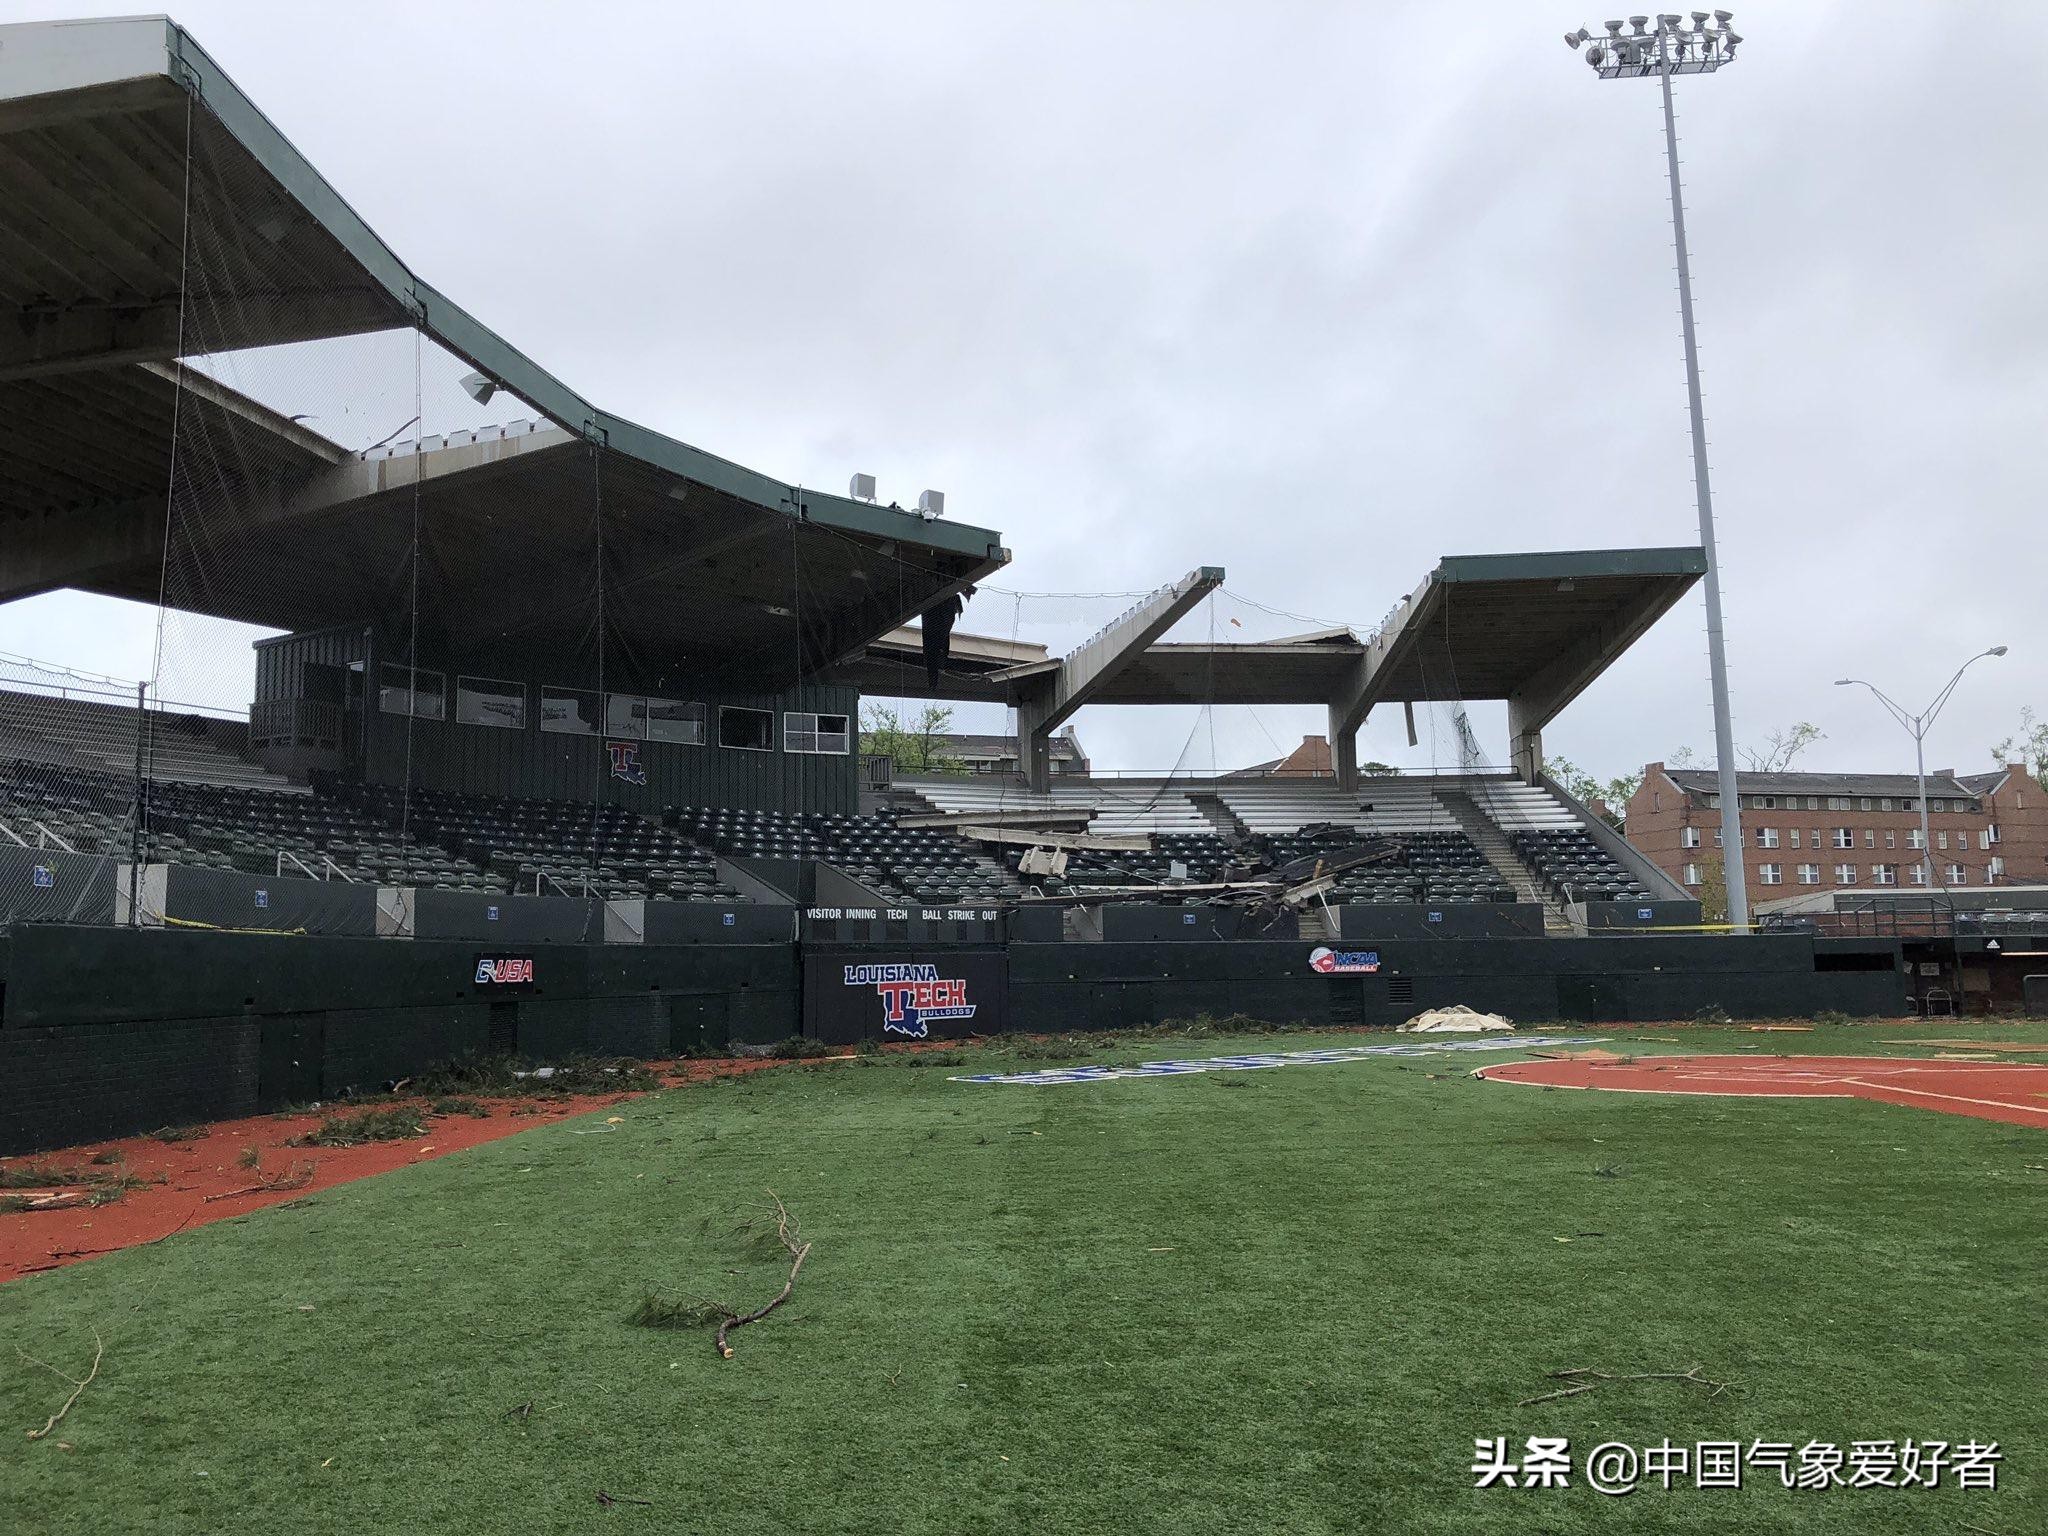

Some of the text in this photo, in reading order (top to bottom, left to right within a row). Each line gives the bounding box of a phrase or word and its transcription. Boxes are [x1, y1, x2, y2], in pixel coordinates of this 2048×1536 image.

[807, 909, 997, 921] VISITOR INNING TECH BALL STRIKE OUT
[1335, 952, 1378, 965] NCAA
[845, 964, 938, 984] LOUISIANA
[878, 980, 966, 1021] TECH
[921, 1008, 971, 1018] BULLDOGS
